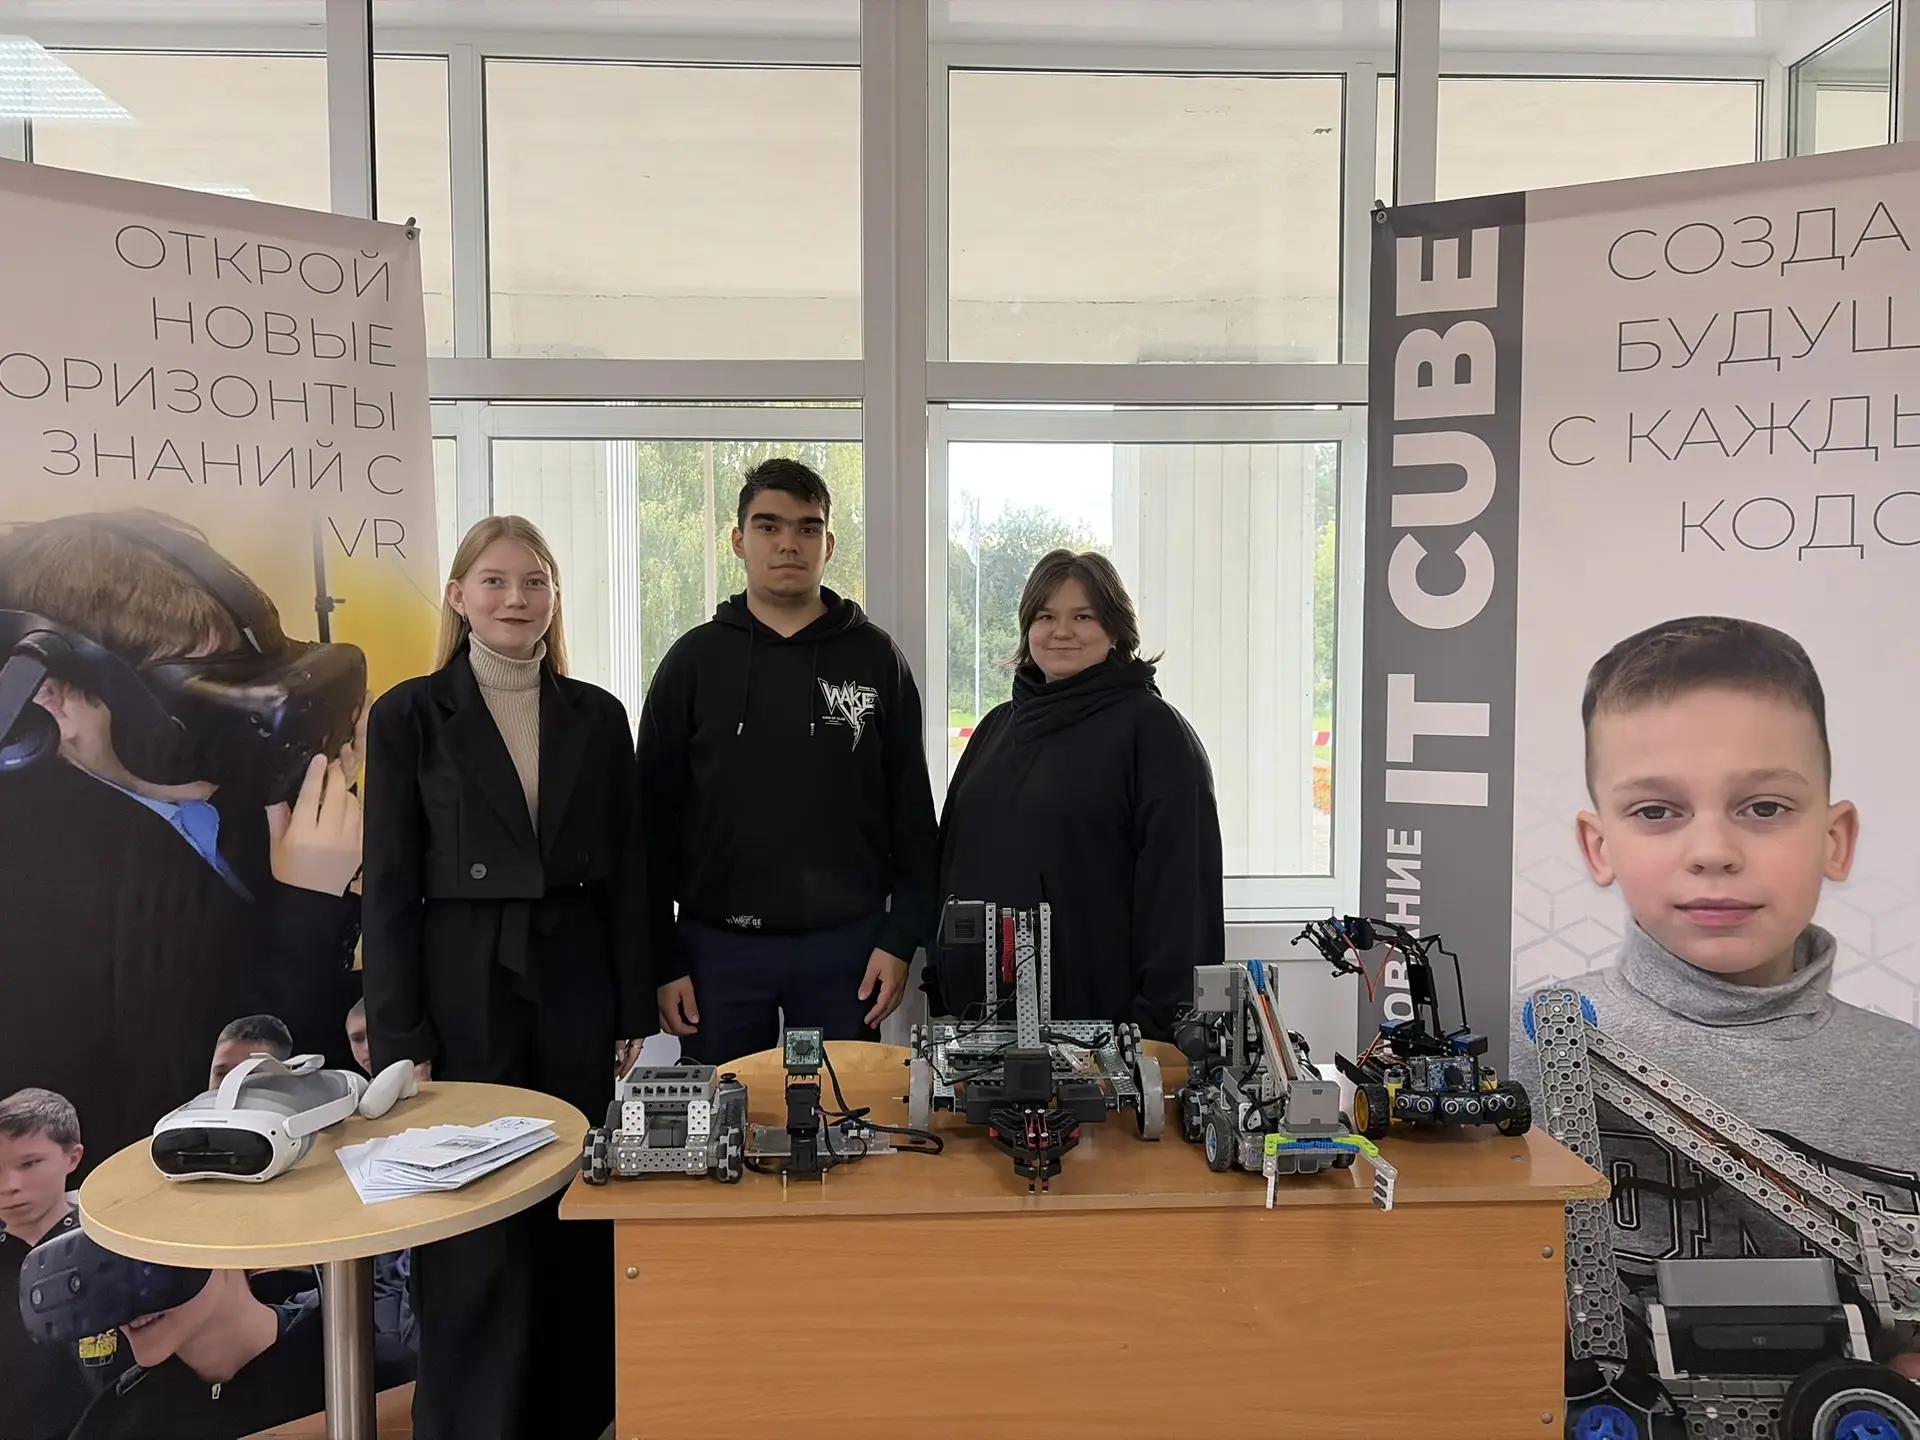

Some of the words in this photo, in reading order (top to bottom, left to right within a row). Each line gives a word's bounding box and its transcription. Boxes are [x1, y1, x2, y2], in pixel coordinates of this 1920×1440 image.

[115, 225, 390, 302] ОТКРОЙ
[1608, 201, 1911, 281] СОЗДА
[152, 296, 397, 367] НОВЫЕ
[0, 352, 396, 431] ОРИЗОНТЫ
[1387, 225, 1500, 630] CUBE
[42, 429, 343, 493] ЗНАНИЙ
[367, 454, 404, 495] С
[1548, 415, 1597, 466] С
[328, 516, 407, 559] VR
[1681, 491, 1920, 561] КОДО
[1385, 673, 1490, 807] IT
